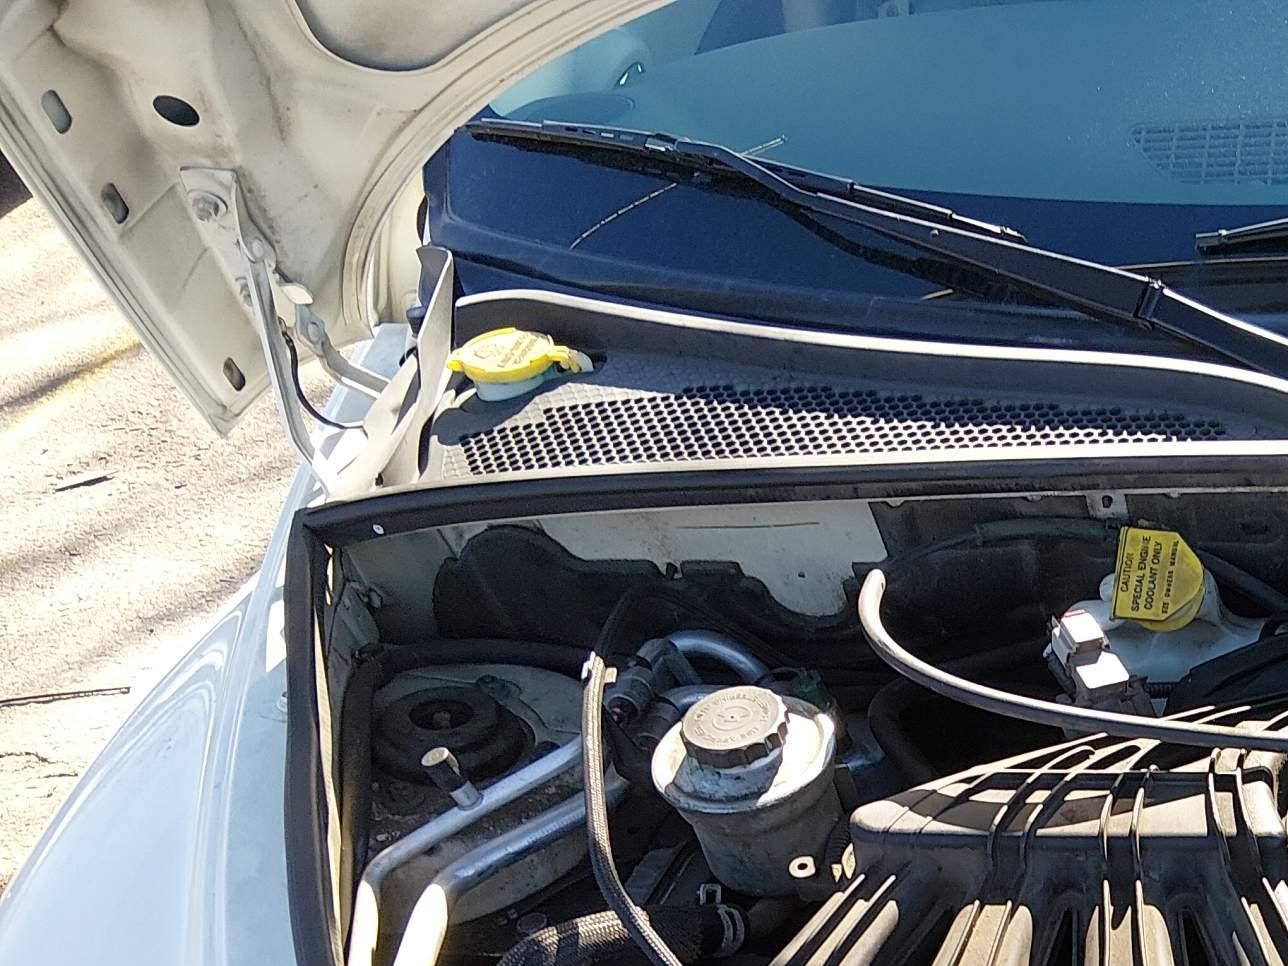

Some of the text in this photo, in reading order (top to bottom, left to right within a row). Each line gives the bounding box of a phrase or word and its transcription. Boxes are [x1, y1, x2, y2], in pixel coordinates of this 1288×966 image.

[1120, 552, 1134, 592] CAUTION
[1131, 535, 1151, 612] SPECIAL ENGINE
[1144, 541, 1162, 610] COOLANT ONLY
[1161, 602, 1169, 614] SEE
